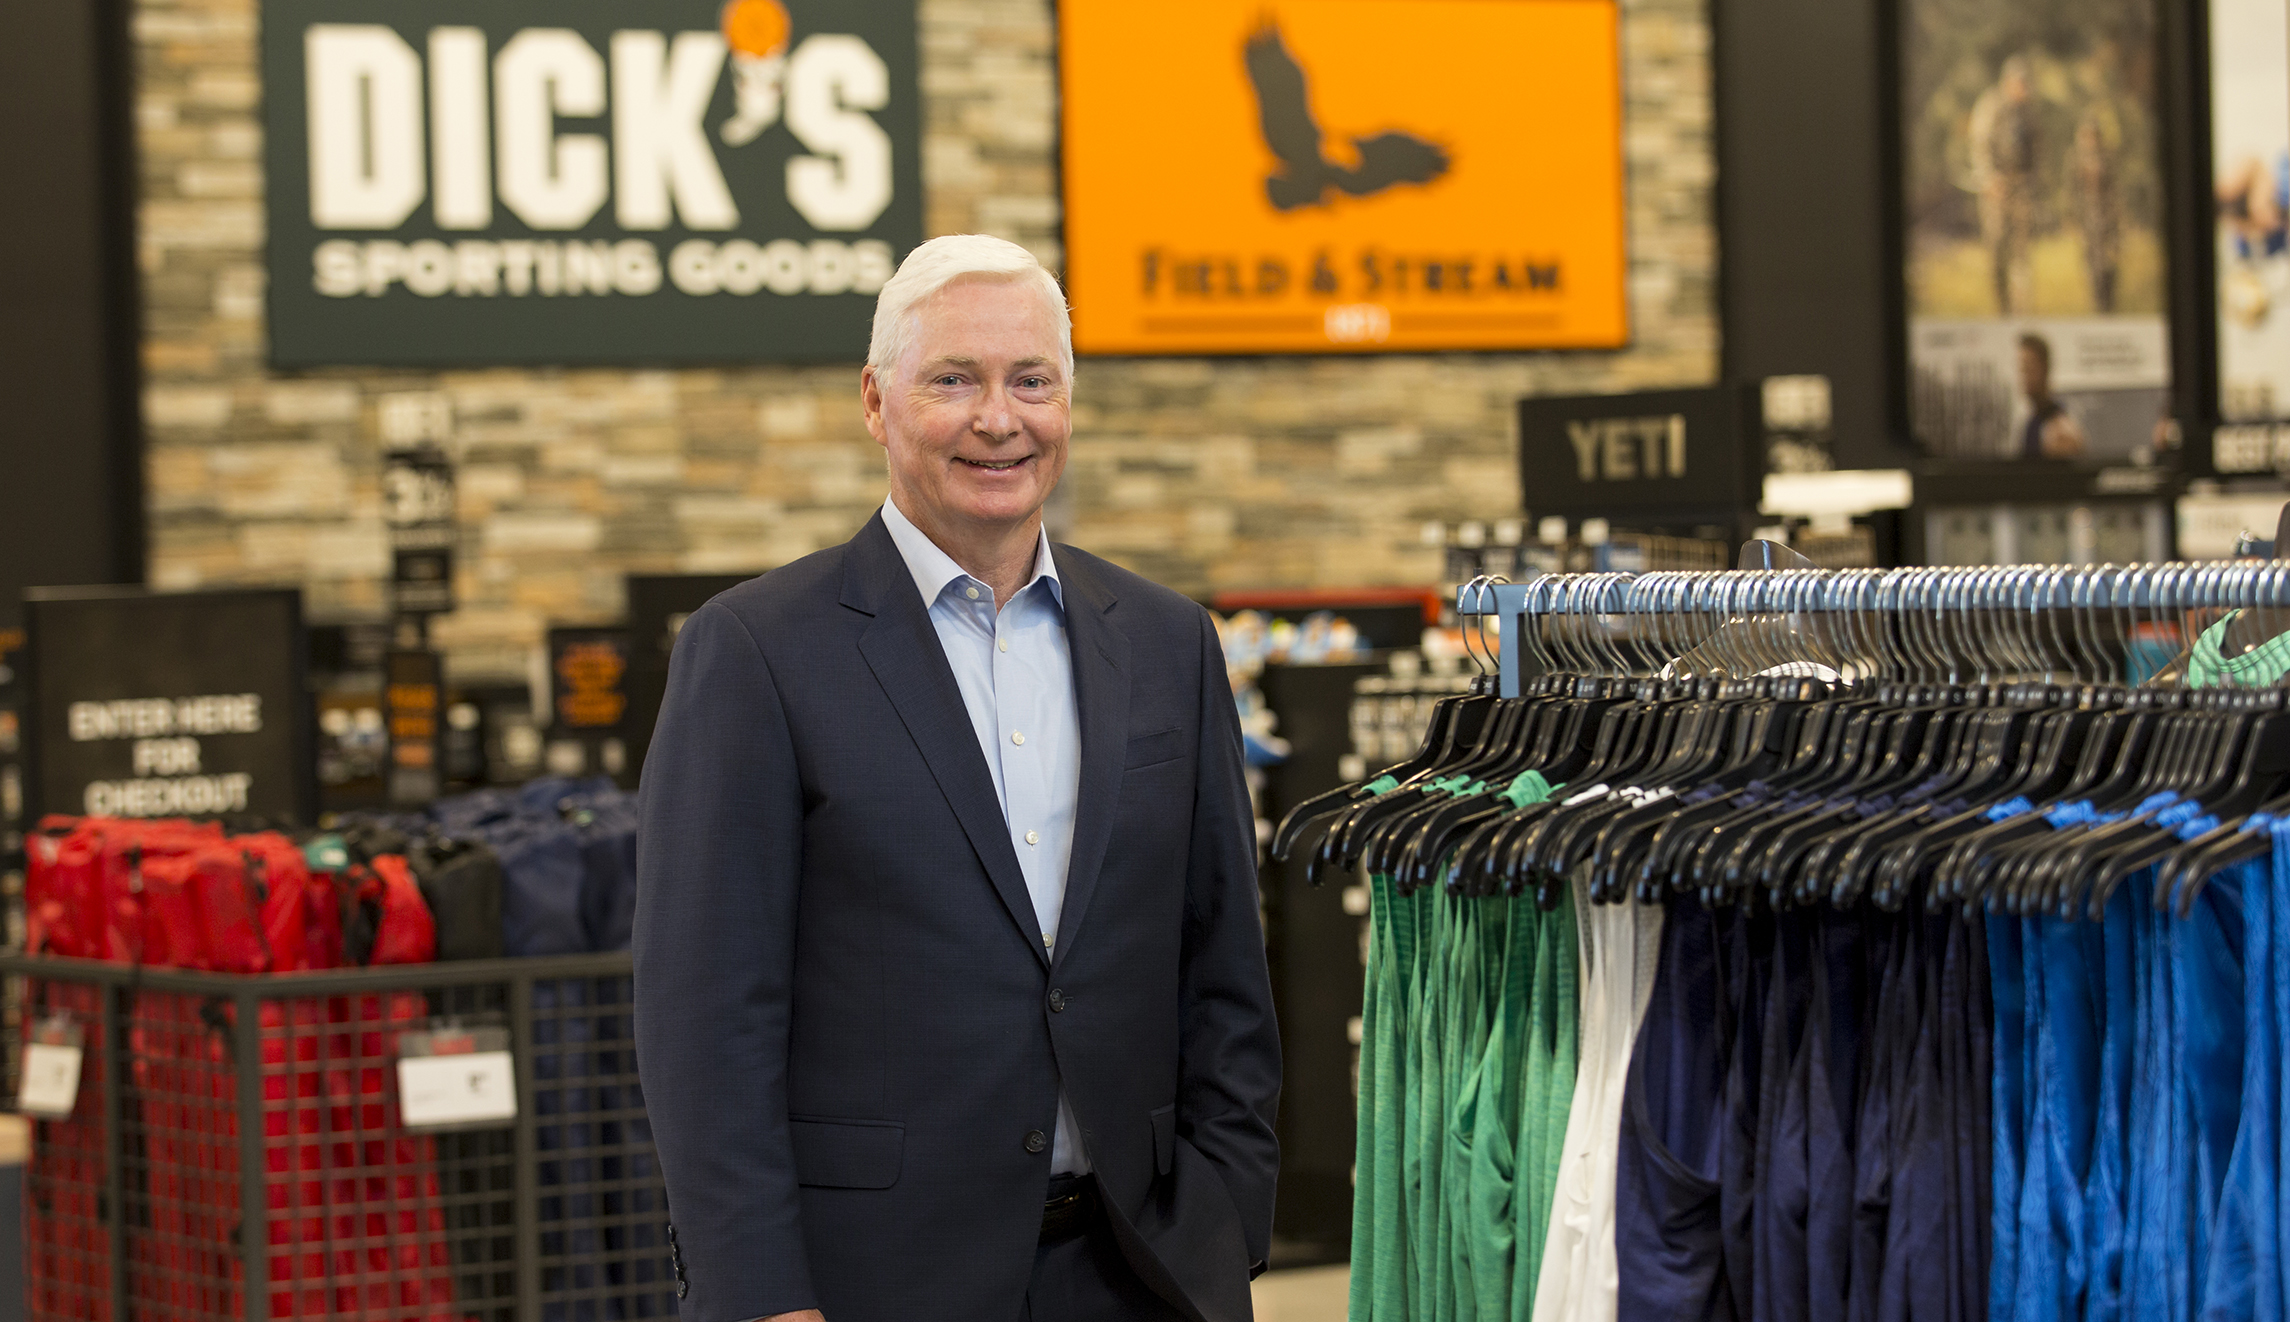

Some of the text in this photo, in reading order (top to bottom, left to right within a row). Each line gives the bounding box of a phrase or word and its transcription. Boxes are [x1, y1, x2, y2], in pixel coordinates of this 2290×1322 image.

[304, 3, 893, 231] DICK'S
[312, 238, 893, 297] SPORTING GOODS
[1139, 246, 1564, 298] FIELD & STREAM
[1567, 413, 1687, 480] YETI
[69, 693, 262, 741] ENTER HERE
[132, 737, 200, 776] FOR
[83, 772, 252, 819] CHECKOUT
